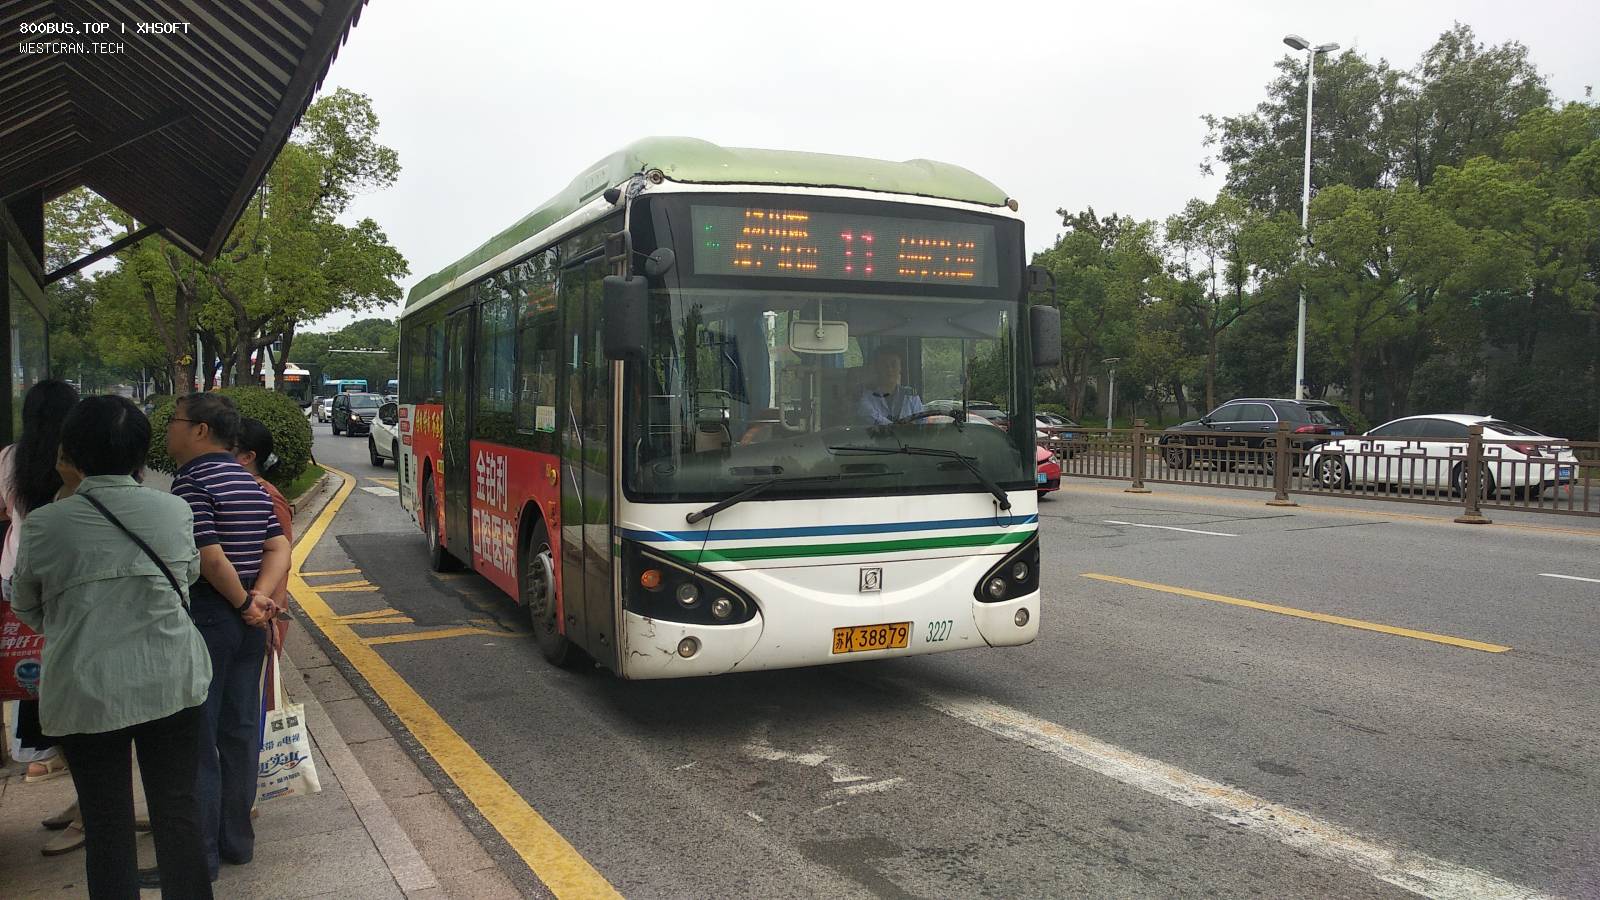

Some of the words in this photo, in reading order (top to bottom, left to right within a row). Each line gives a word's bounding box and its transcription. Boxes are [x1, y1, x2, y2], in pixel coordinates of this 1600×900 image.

[472, 509, 515, 577] 口腔医院
[925, 620, 953, 643] 3227
